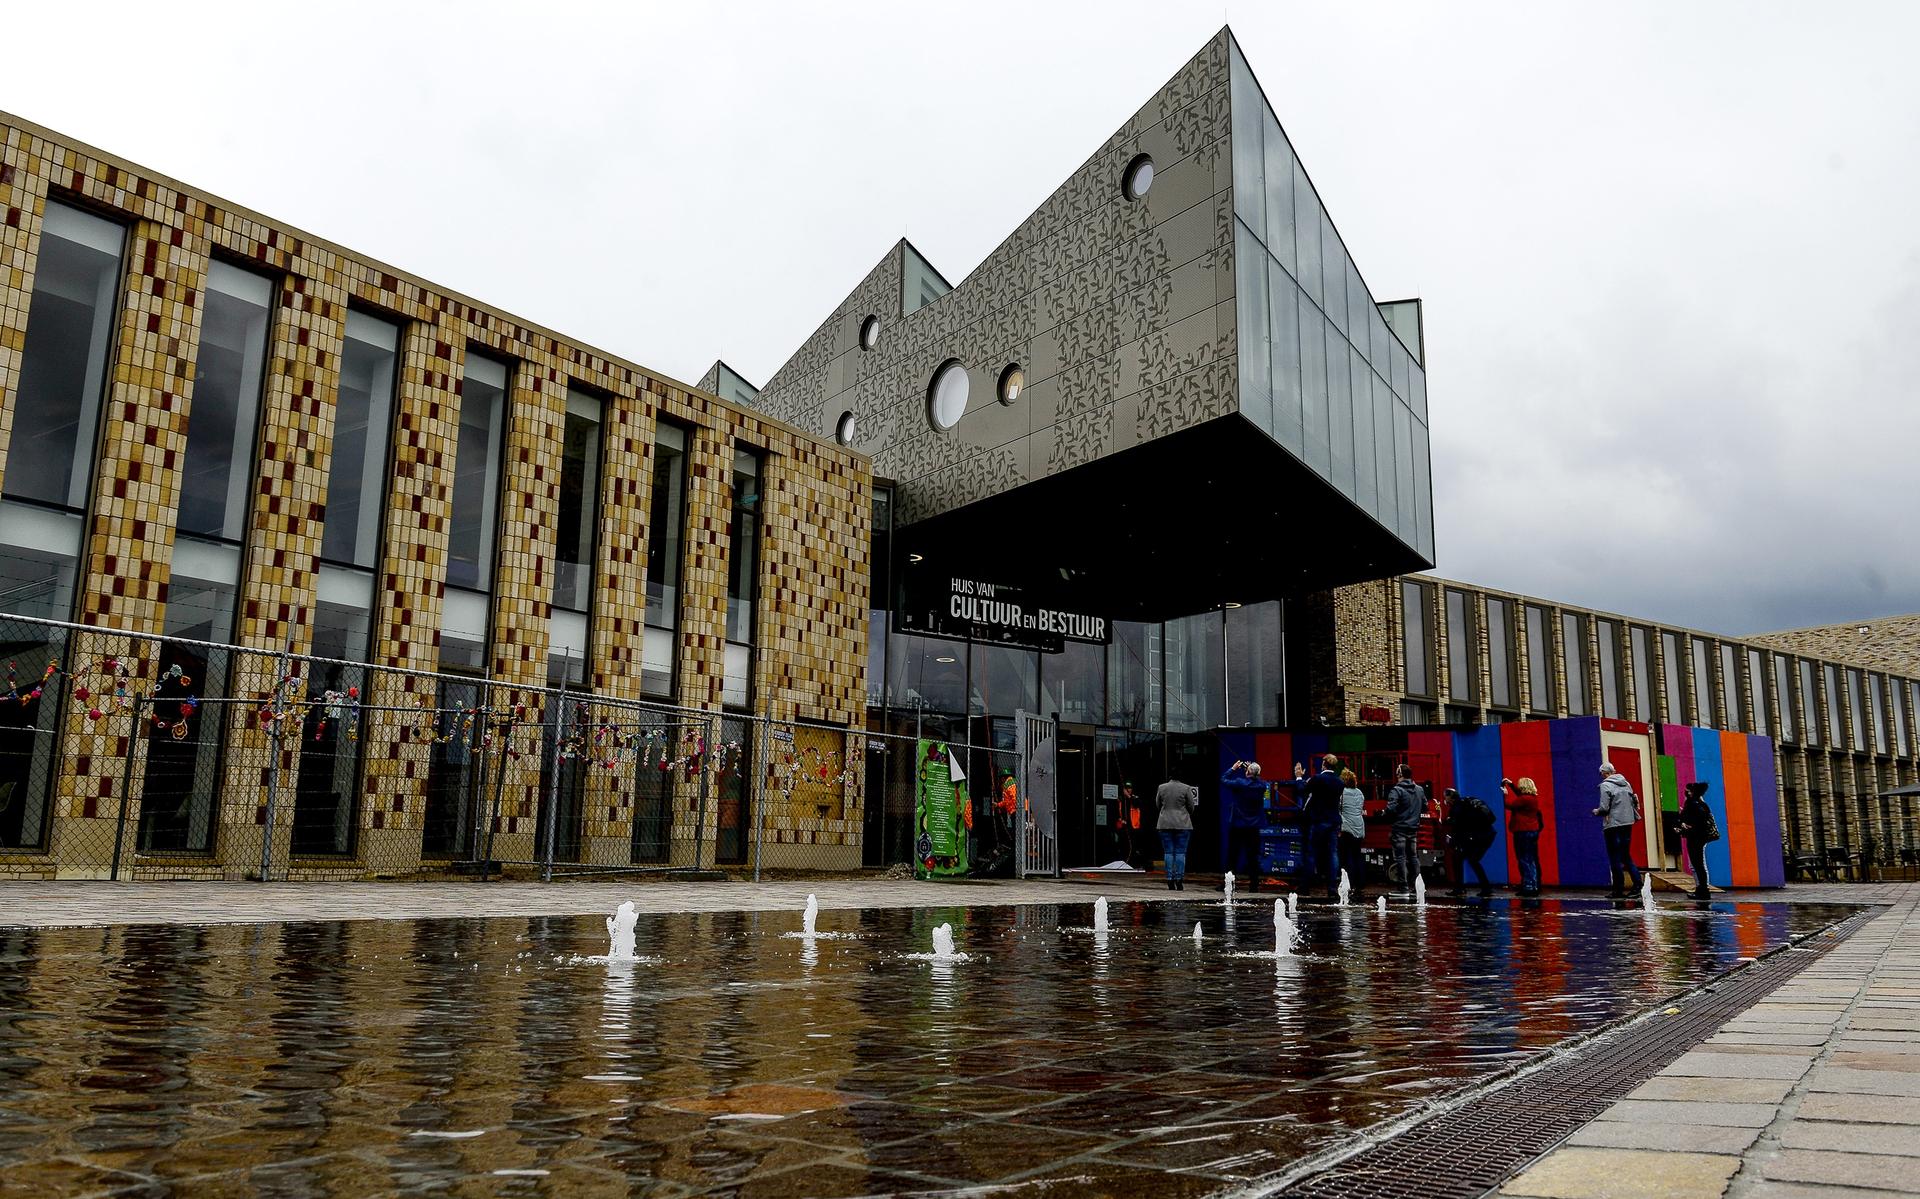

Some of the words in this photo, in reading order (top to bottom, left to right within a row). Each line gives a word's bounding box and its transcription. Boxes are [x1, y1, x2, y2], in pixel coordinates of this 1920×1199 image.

[951, 577, 974, 595] HUIS
[976, 581, 995, 598] VAN
[950, 594, 1022, 627] CULTUUR
[1024, 614, 1037, 629] EN
[1038, 608, 1105, 639] BESTUUR
